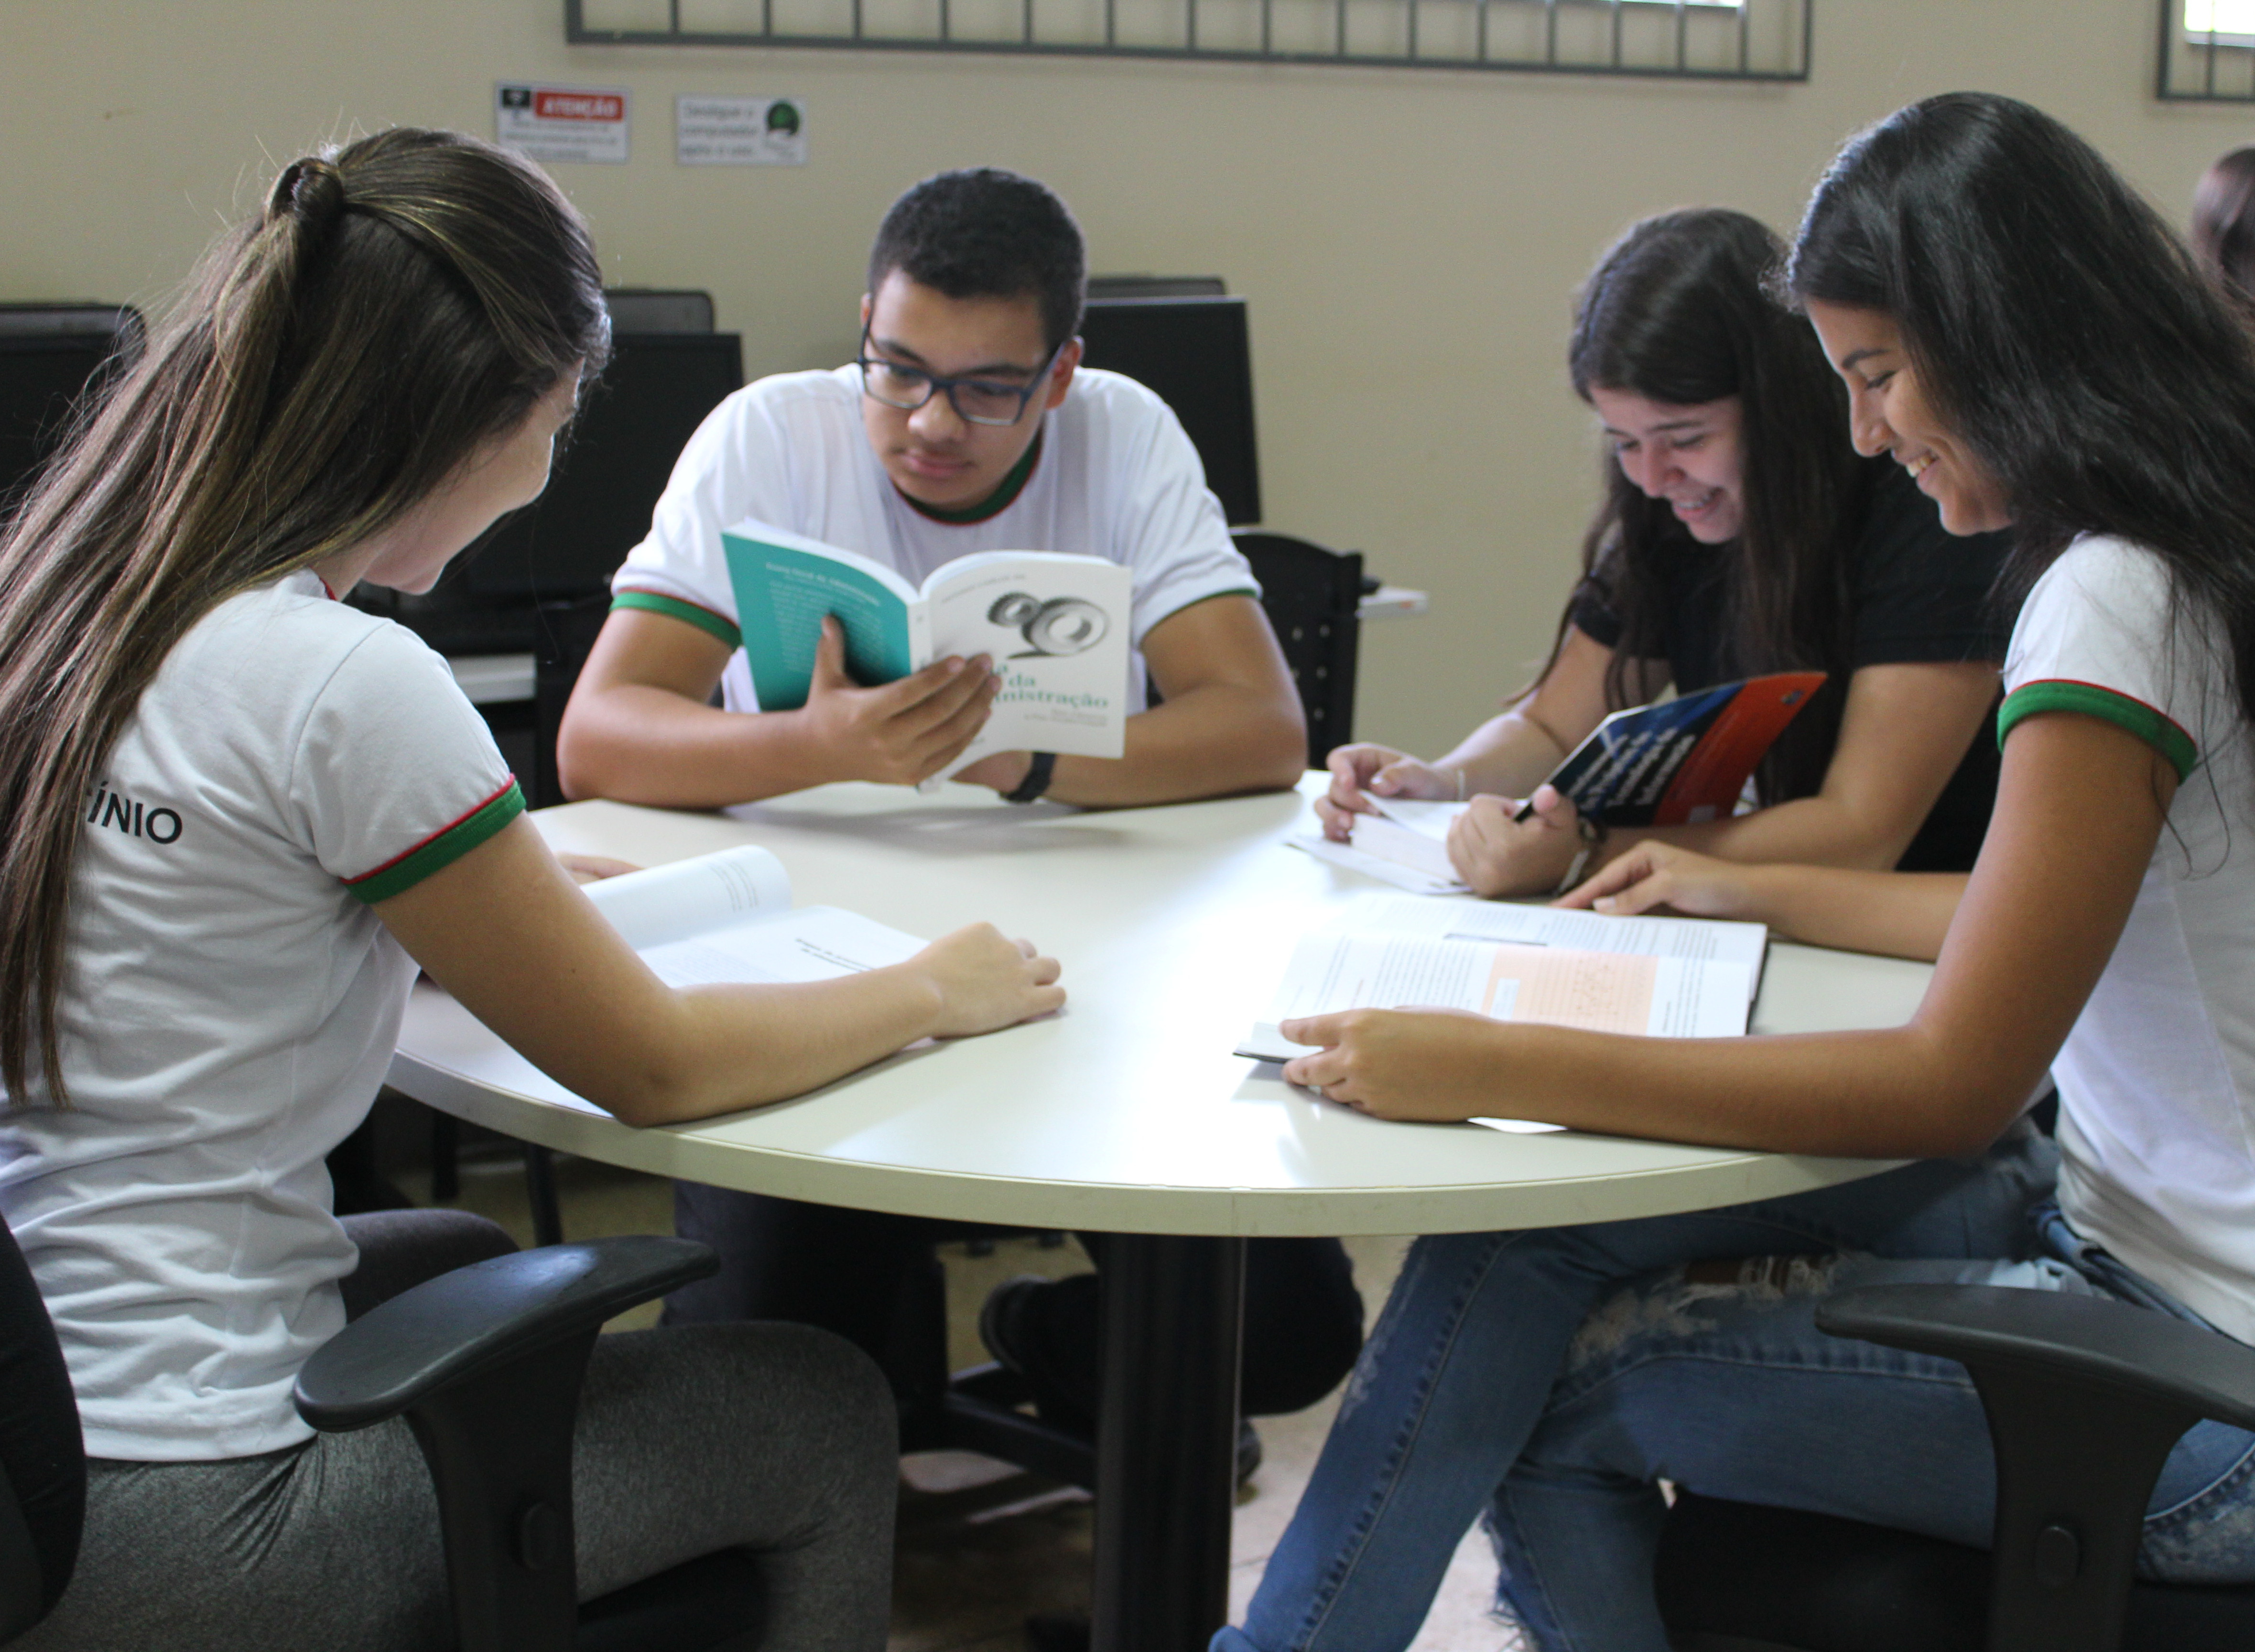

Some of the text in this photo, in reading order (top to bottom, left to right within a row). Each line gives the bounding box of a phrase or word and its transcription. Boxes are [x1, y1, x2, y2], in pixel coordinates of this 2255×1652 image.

[543, 97, 618, 117] ATENÇÃO
[1008, 673, 1036, 687] da
[86, 781, 183, 844] ÍNIO
